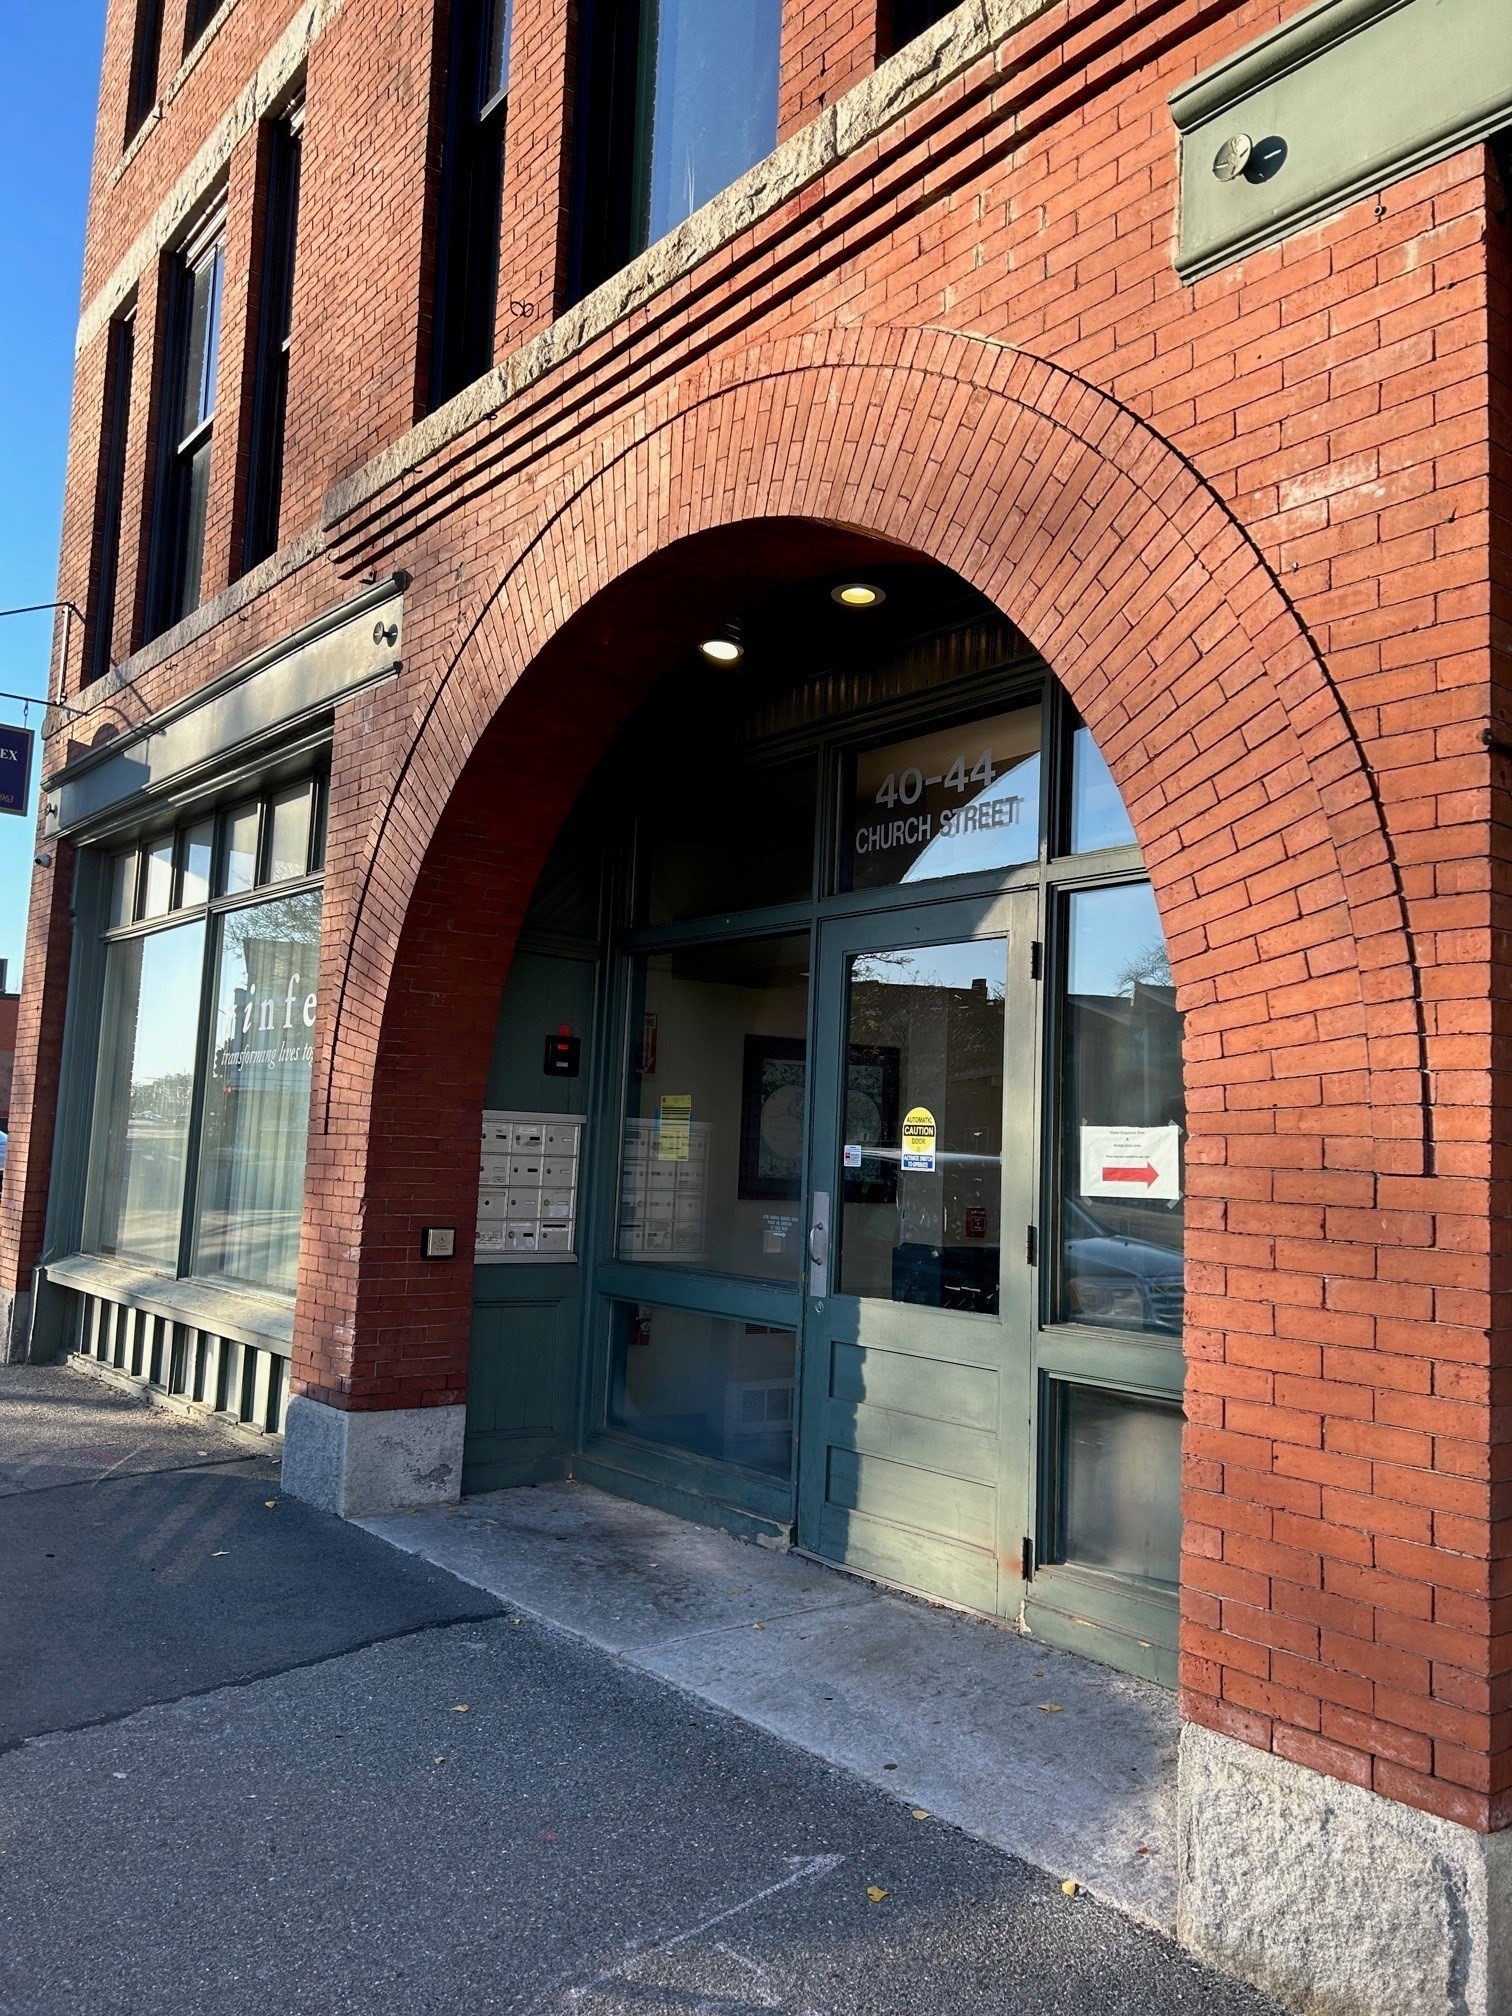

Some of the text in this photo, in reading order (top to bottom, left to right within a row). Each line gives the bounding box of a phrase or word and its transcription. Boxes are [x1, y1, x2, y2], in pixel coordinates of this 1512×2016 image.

[0, 748, 19, 762] EX
[875, 748, 997, 809] 40-44
[855, 795, 1020, 854] CHURCH STREET
[220, 1044, 278, 1072] transforming
[278, 1041, 301, 1062] lives
[904, 1126, 933, 1135] CAUTION
